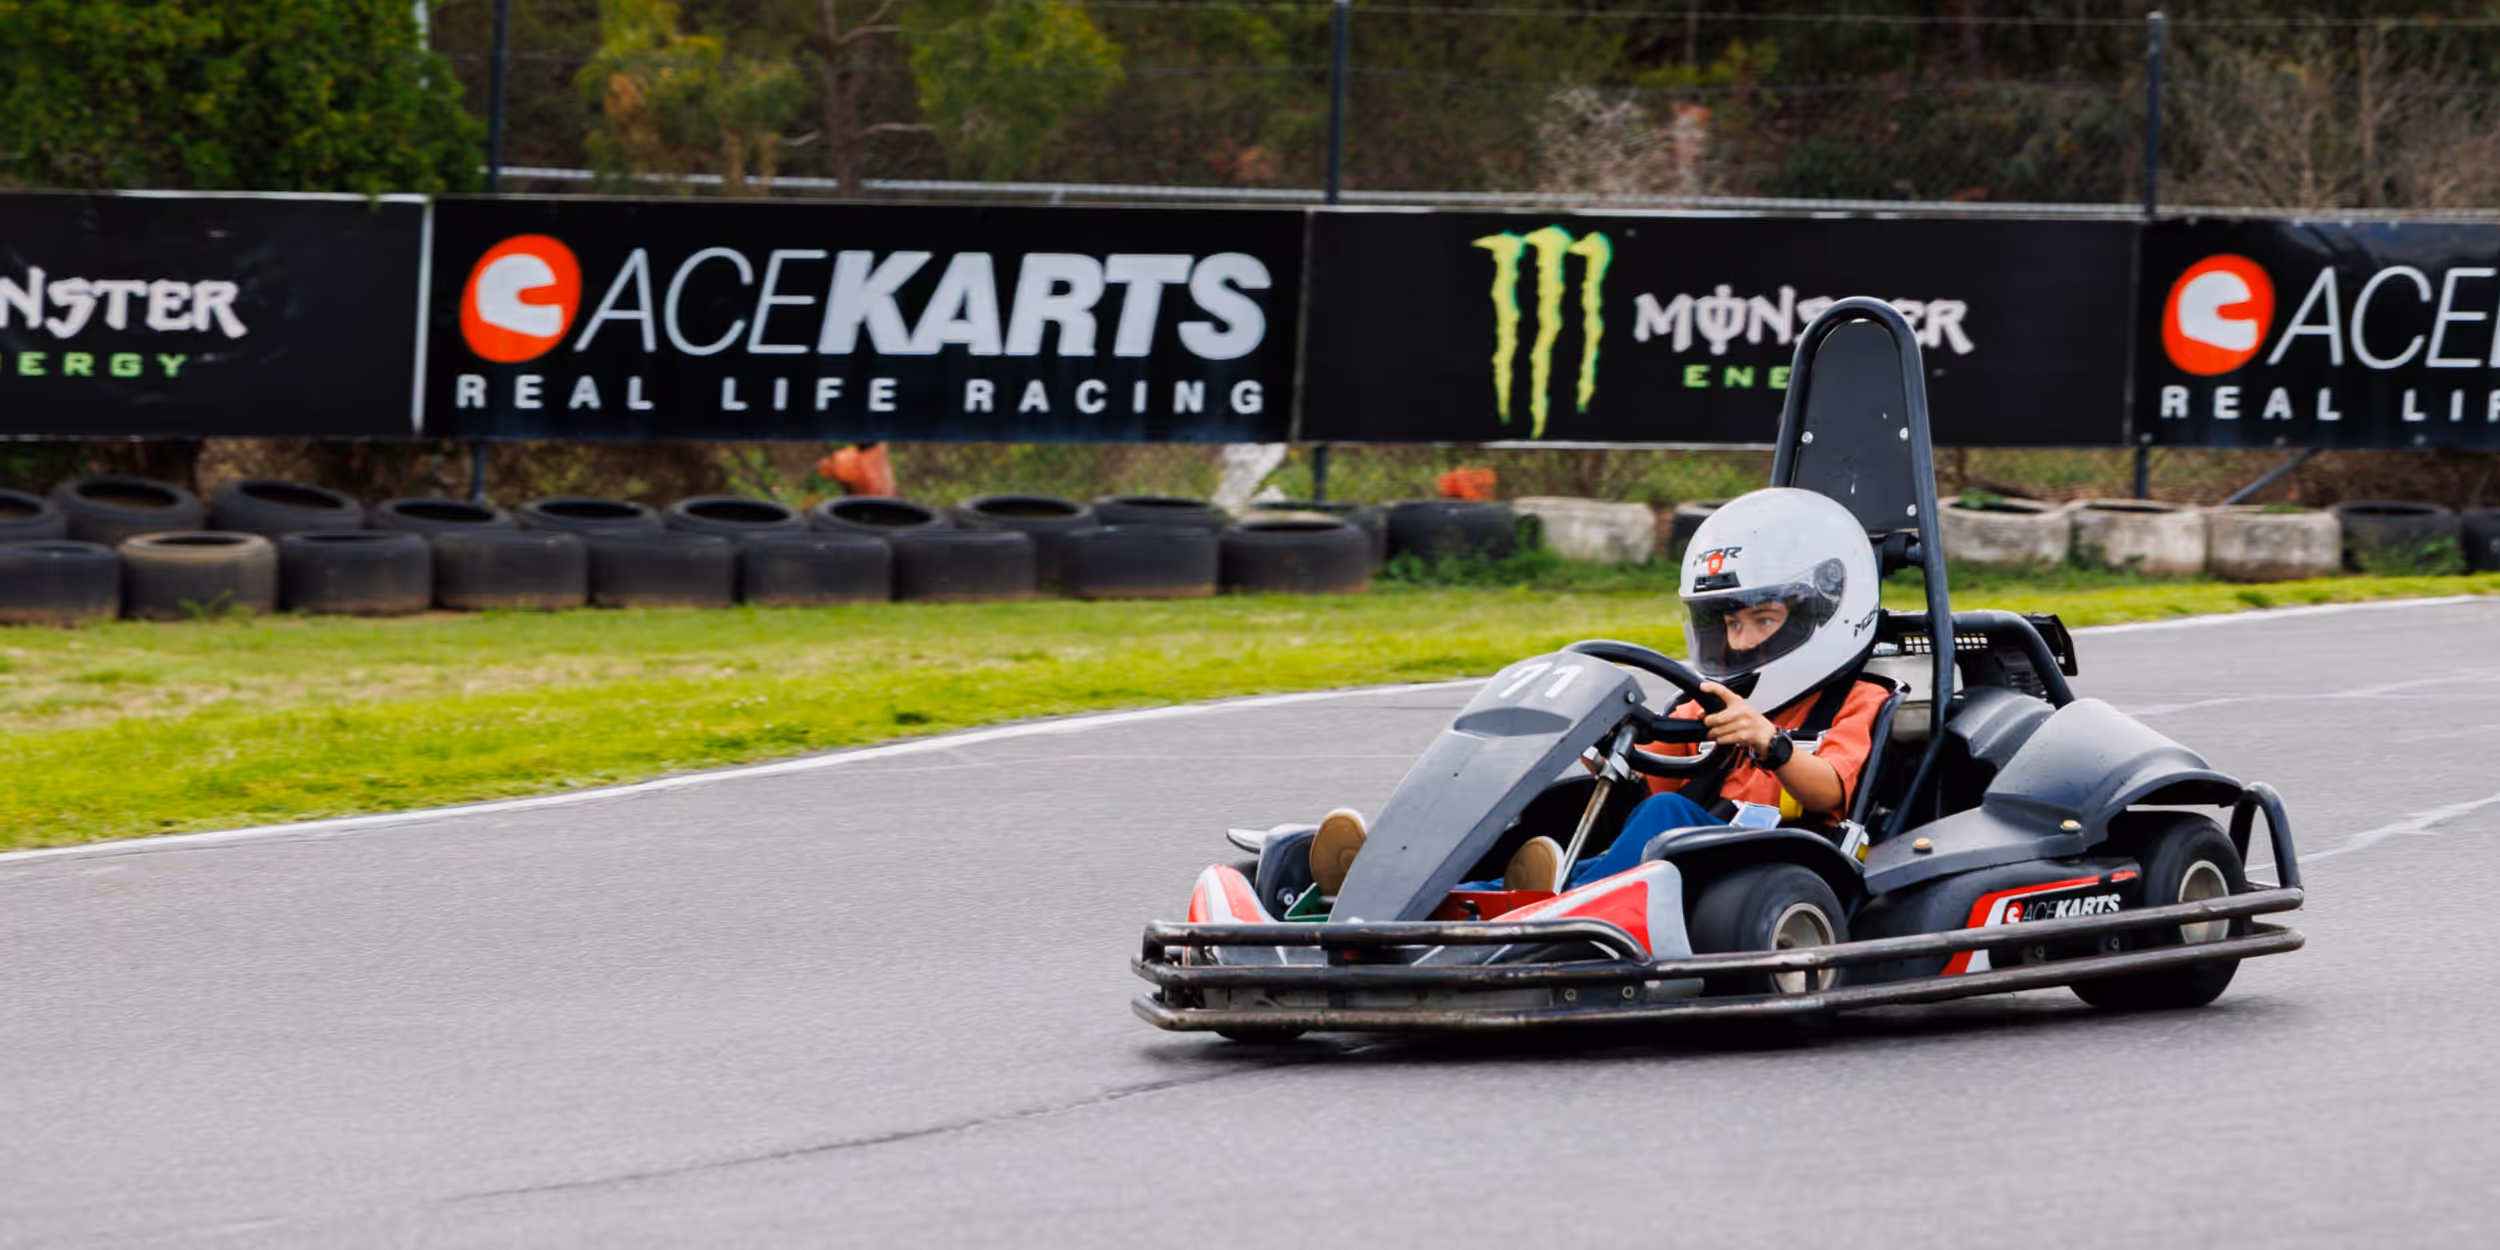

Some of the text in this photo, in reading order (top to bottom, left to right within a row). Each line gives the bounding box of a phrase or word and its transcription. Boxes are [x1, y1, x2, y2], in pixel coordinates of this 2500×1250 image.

[574, 247, 1271, 360] ACEKARTS
[2266, 265, 2500, 368] ACE
[0, 352, 188, 377] ERGY
[457, 374, 1263, 415] REAL LIFE RACING
[2160, 385, 2341, 421] REAL
